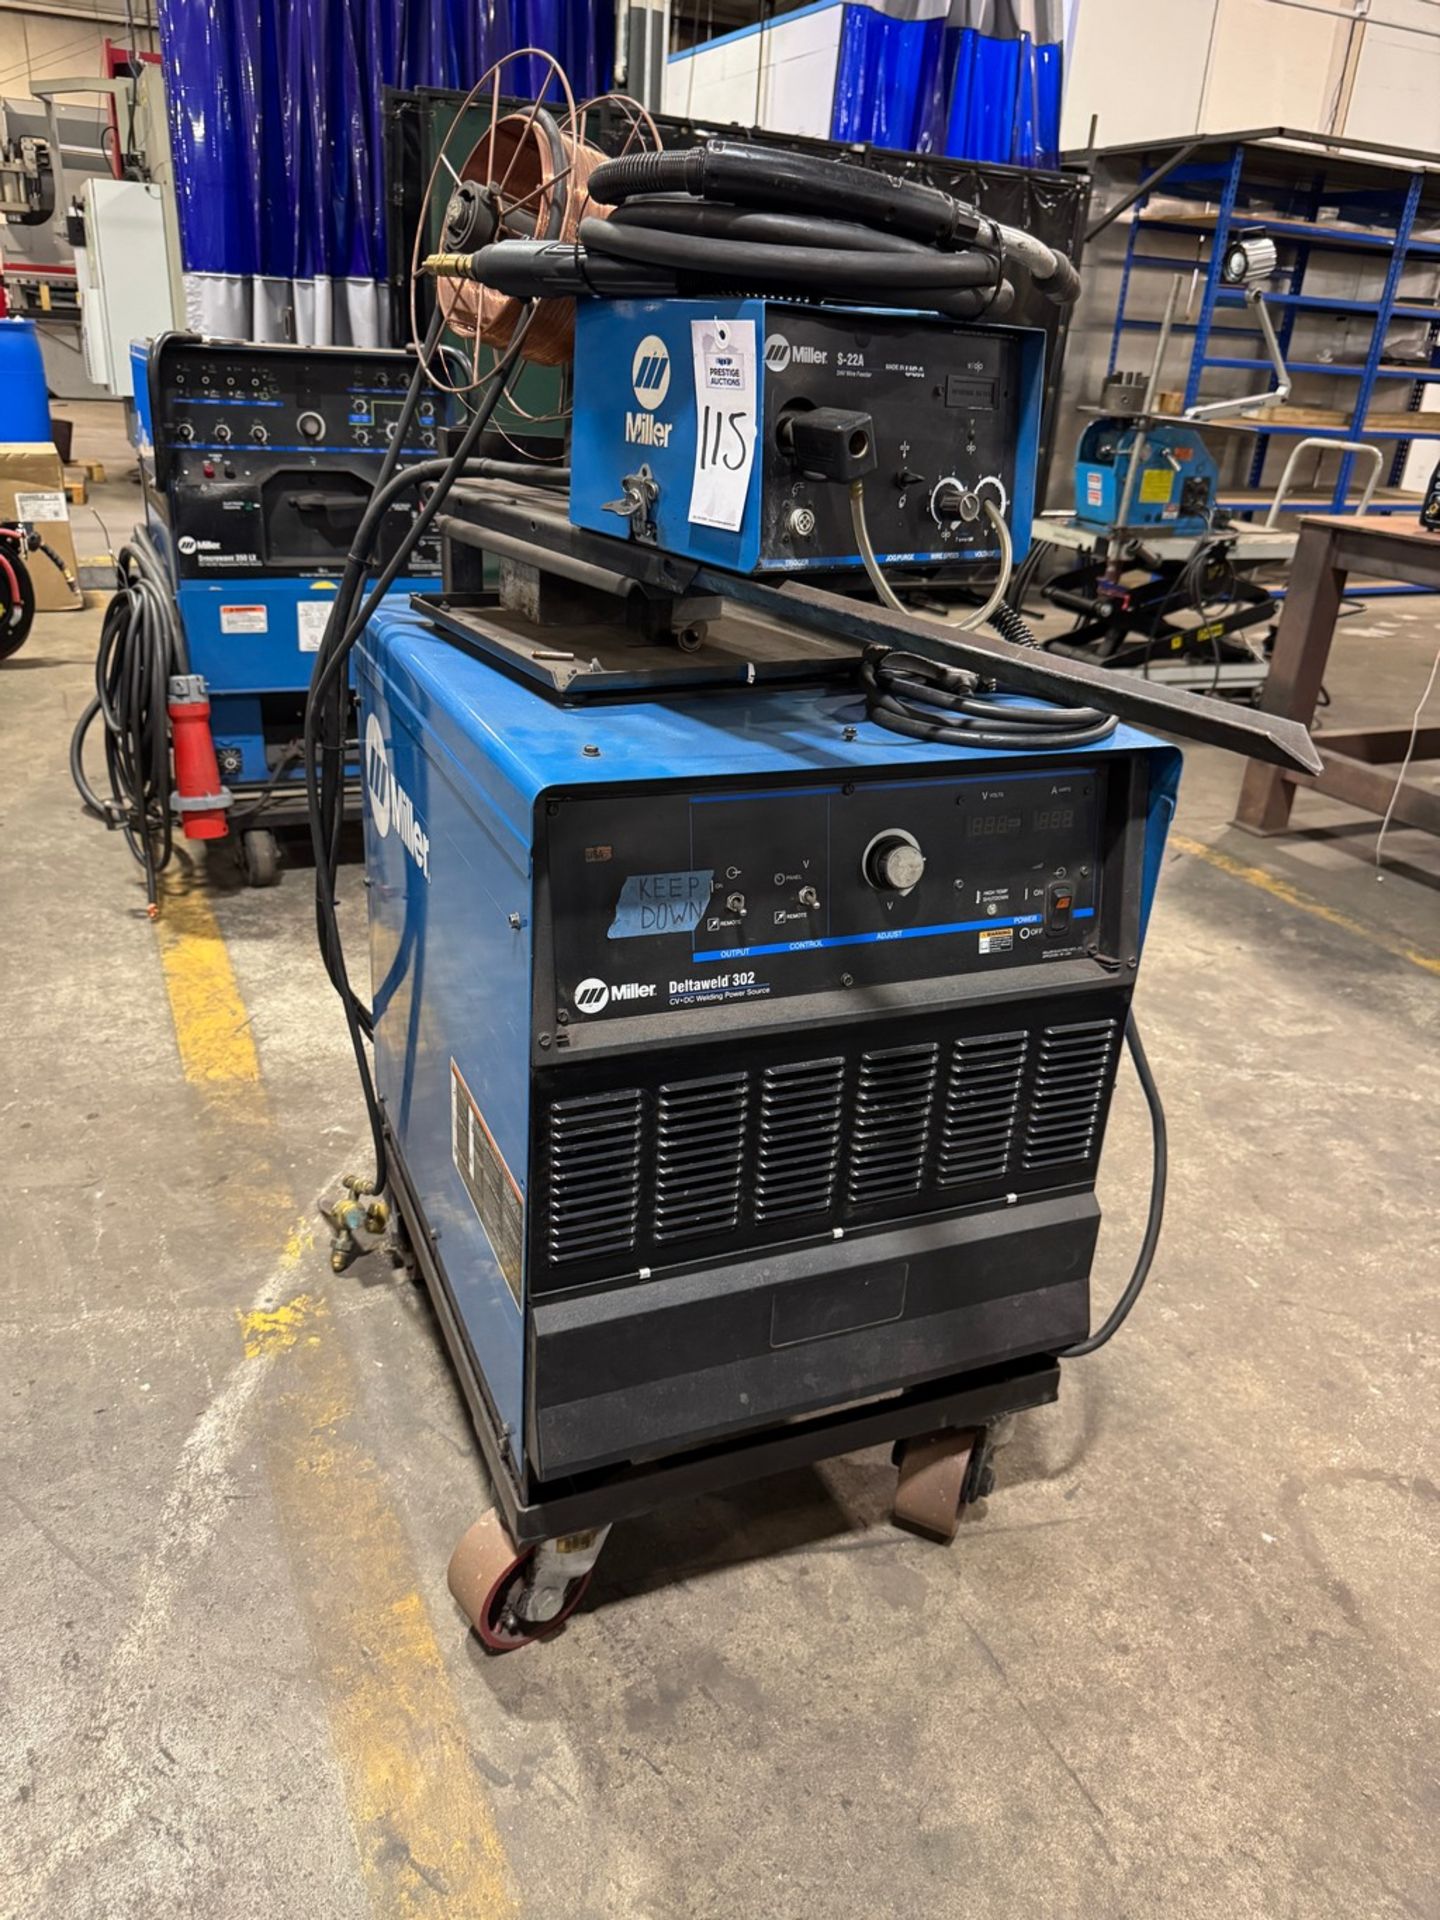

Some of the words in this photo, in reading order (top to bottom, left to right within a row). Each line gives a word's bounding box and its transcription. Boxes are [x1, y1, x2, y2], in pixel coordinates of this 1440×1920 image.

[792, 346, 827, 364] Miller
[837, 352, 864, 367] S-22A
[709, 367, 740, 377] PRESTIGE
[710, 377, 741, 387] AUCTIONS
[625, 411, 672, 448] Miller
[701, 405, 747, 471] 115
[196, 540, 221, 550] Miller
[390, 772, 430, 882] Miller
[803, 859, 810, 869] V
[638, 876, 701, 900] KEEP
[1033, 889, 1044, 897] ON
[640, 901, 702, 930] DOWN
[787, 912, 808, 920] REMOTE
[1013, 914, 1037, 925] POWER
[720, 919, 742, 927] REMOTE
[876, 930, 902, 941] ADJUST
[1030, 927, 1043, 935] OFF
[788, 940, 823, 951] CONTROL
[720, 947, 750, 958] OUTPUT
[611, 982, 657, 1002] Miller
[669, 973, 730, 994] Deltaweld
[732, 971, 755, 987] 302
[696, 991, 724, 1001] Welding
[725, 987, 746, 998] Power
[747, 985, 771, 995] Source
